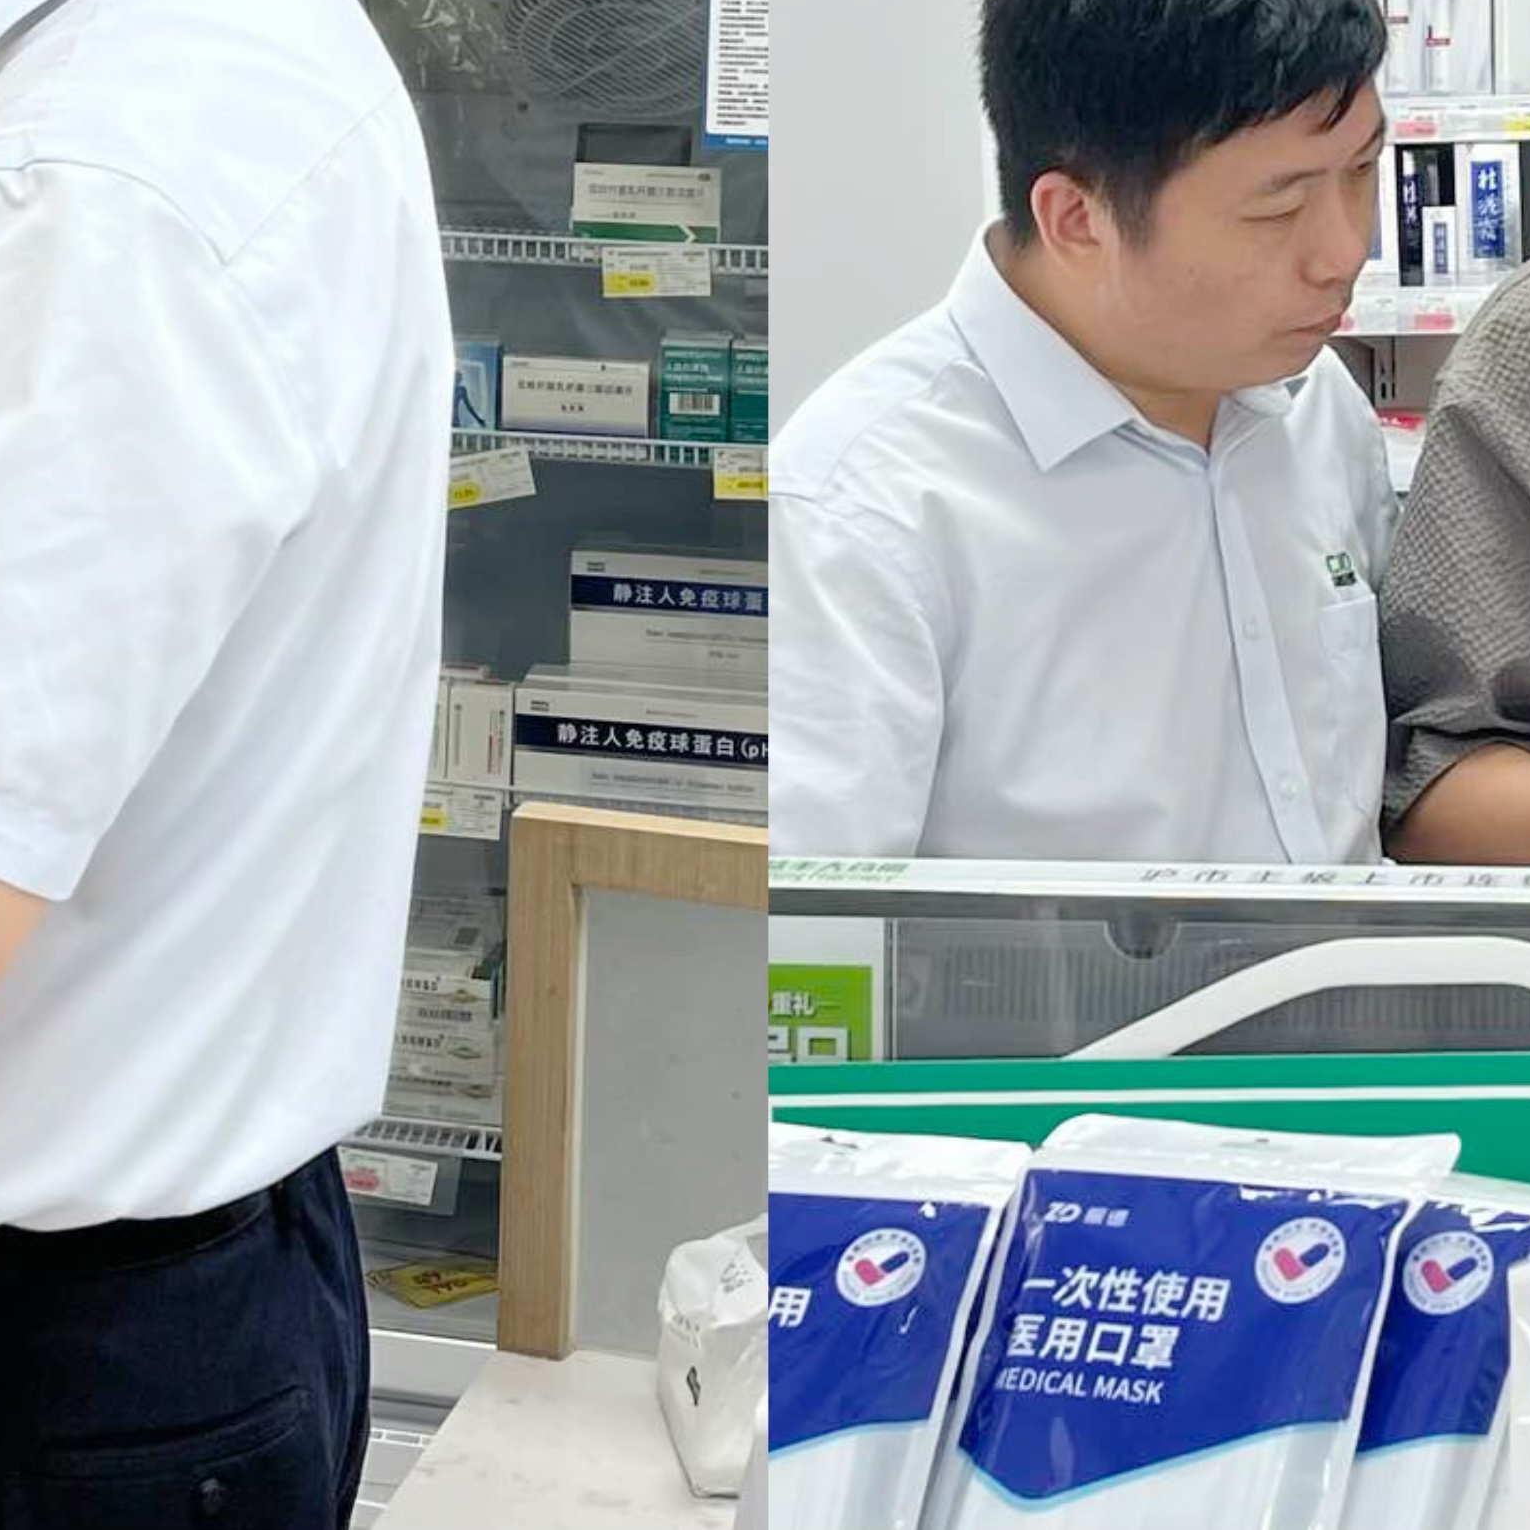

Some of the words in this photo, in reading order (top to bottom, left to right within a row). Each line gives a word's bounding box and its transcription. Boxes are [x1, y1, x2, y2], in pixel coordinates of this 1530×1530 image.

[1023, 1264, 1232, 1322] 一次性使用
[1006, 1313, 1180, 1370] 医用口罩
[1091, 1375, 1165, 1405] MASK
